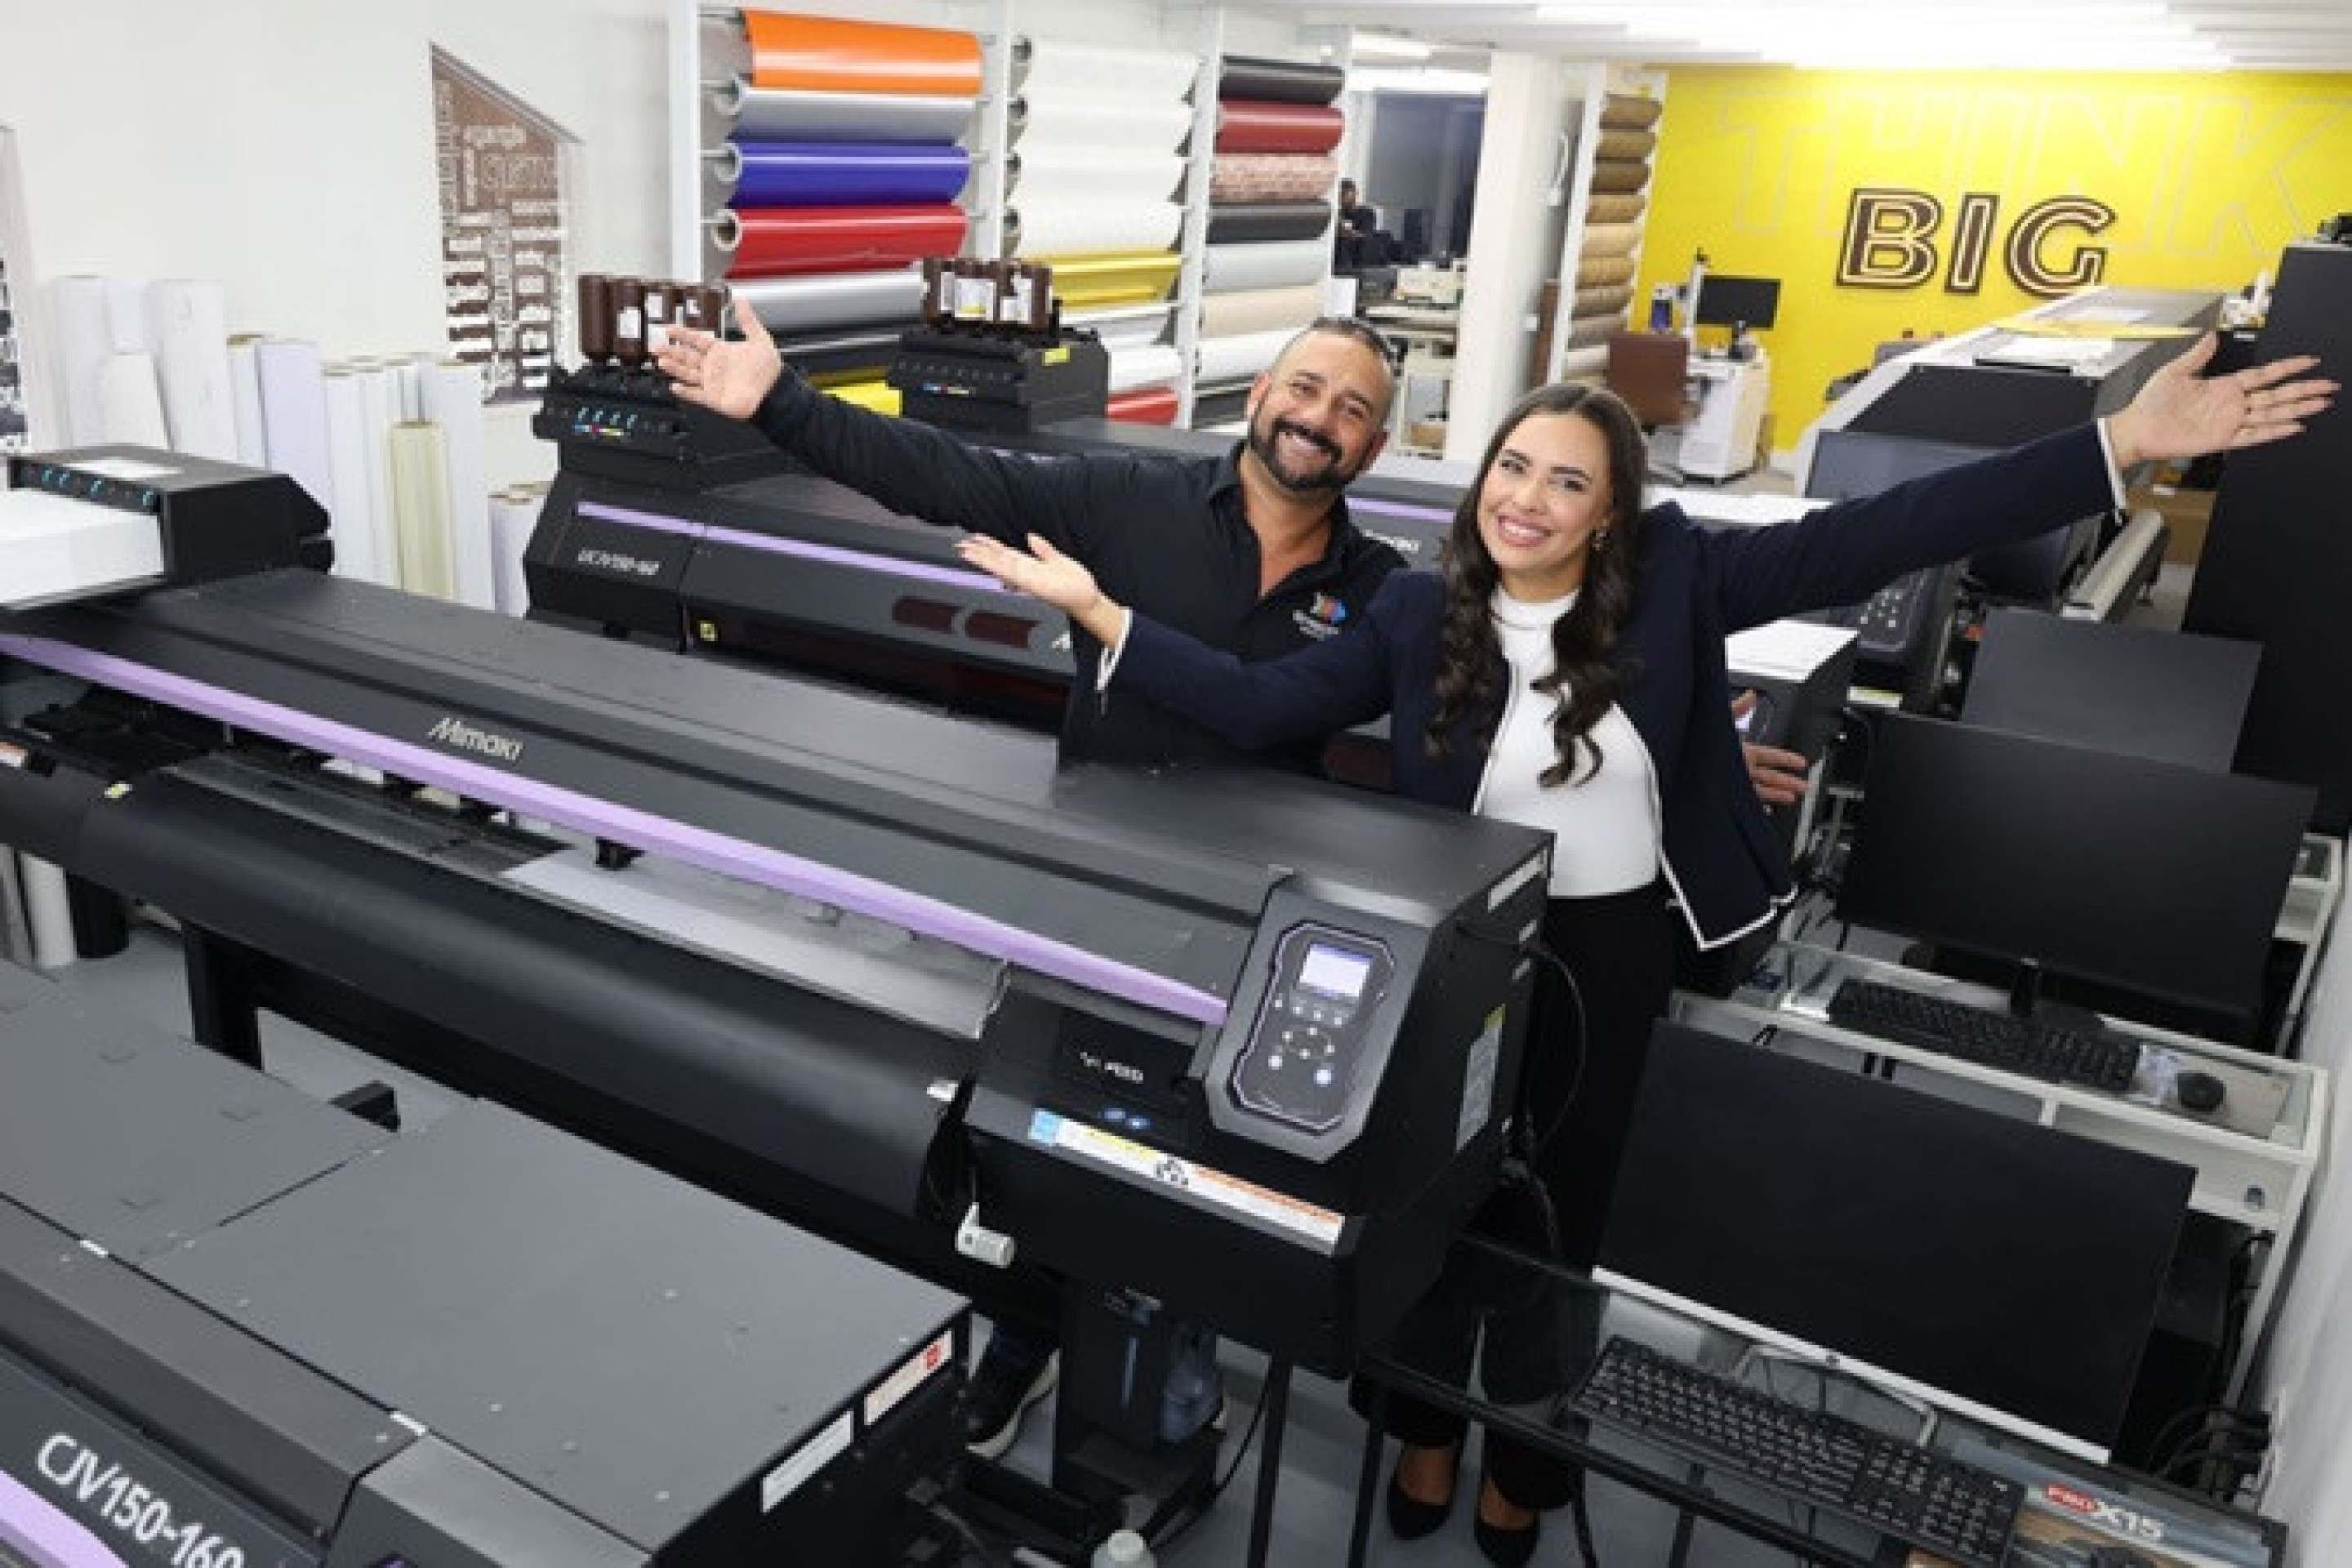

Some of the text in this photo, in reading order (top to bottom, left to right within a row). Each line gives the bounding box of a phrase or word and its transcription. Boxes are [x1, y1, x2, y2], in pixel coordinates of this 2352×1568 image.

[1718, 88, 2352, 256] THINK
[1835, 187, 2118, 296] BIG
[428, 718, 523, 760] Mimaki
